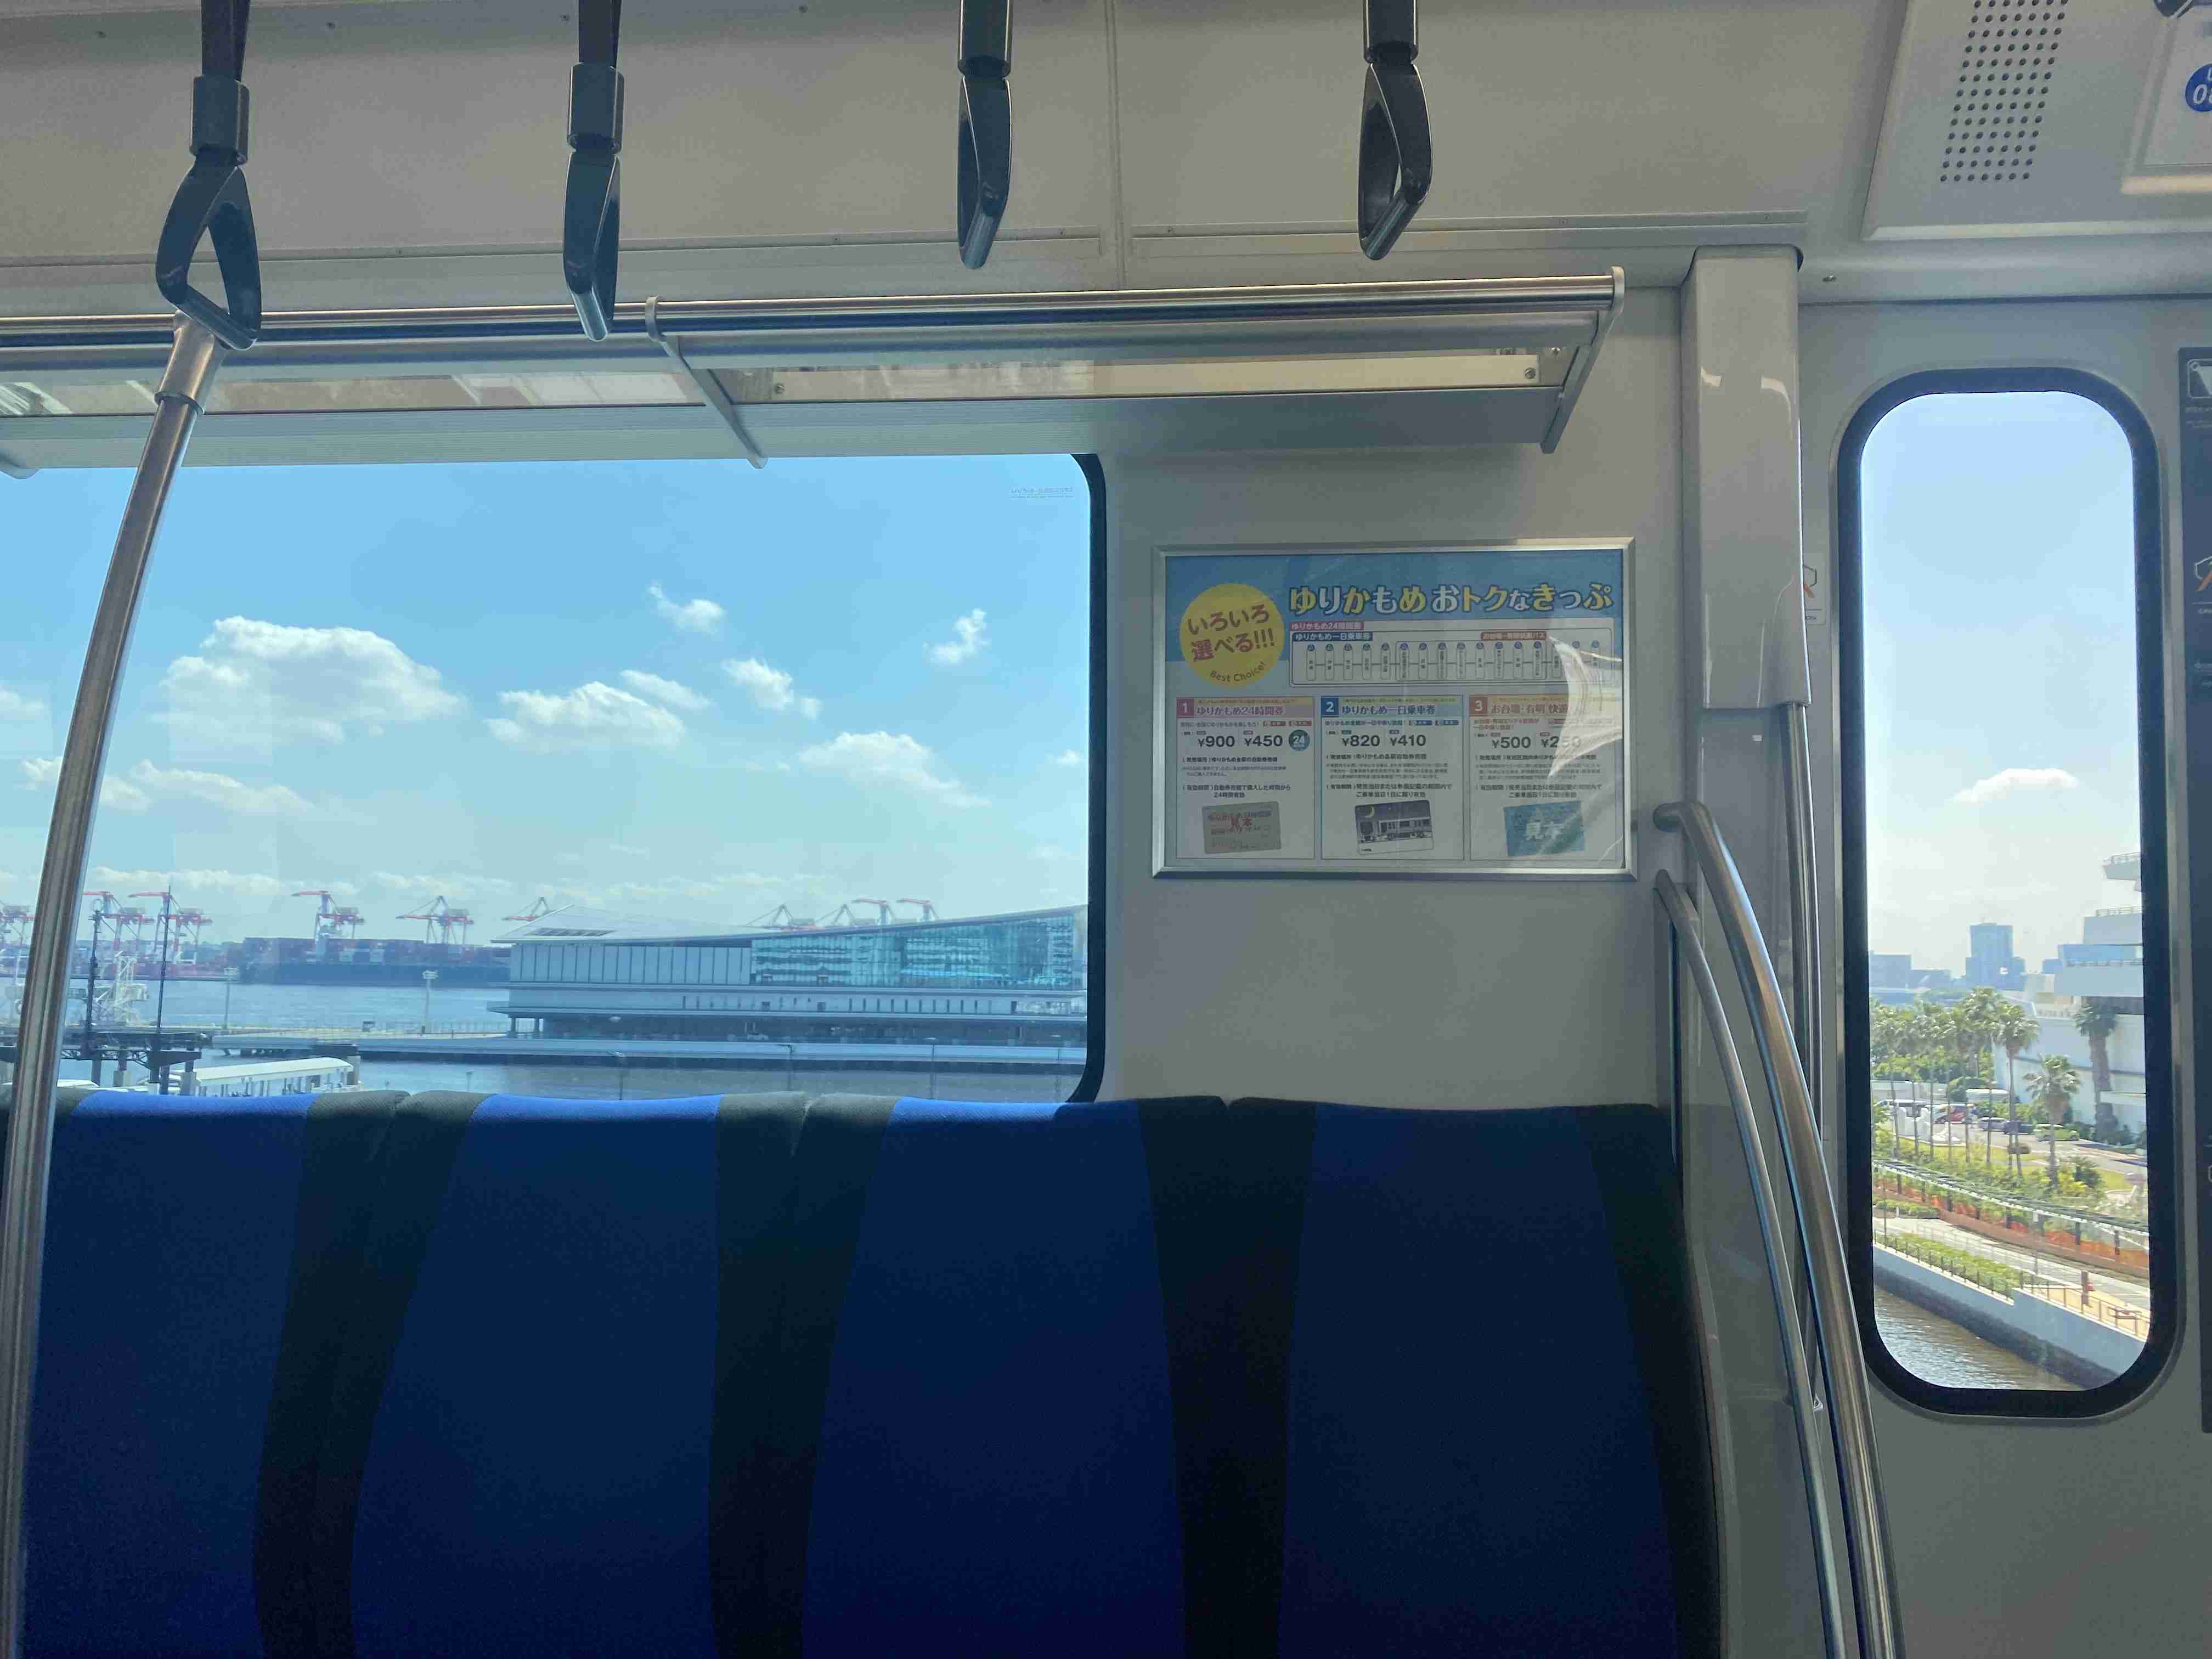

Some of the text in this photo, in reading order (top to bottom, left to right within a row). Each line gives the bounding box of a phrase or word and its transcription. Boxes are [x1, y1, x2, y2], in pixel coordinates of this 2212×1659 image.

[2193, 84, 2212, 104] 0
[1188, 604, 1269, 635] いろいろ
[1211, 670, 1231, 682] Best
[1182, 702, 1188, 713] 1
[1326, 701, 1335, 713] 2
[1474, 700, 1483, 712] 3
[1198, 735, 1283, 747] ¥900 ¥450
[1342, 734, 1426, 747] ¥820 ¥410
[1492, 736, 1531, 748] ¥500
